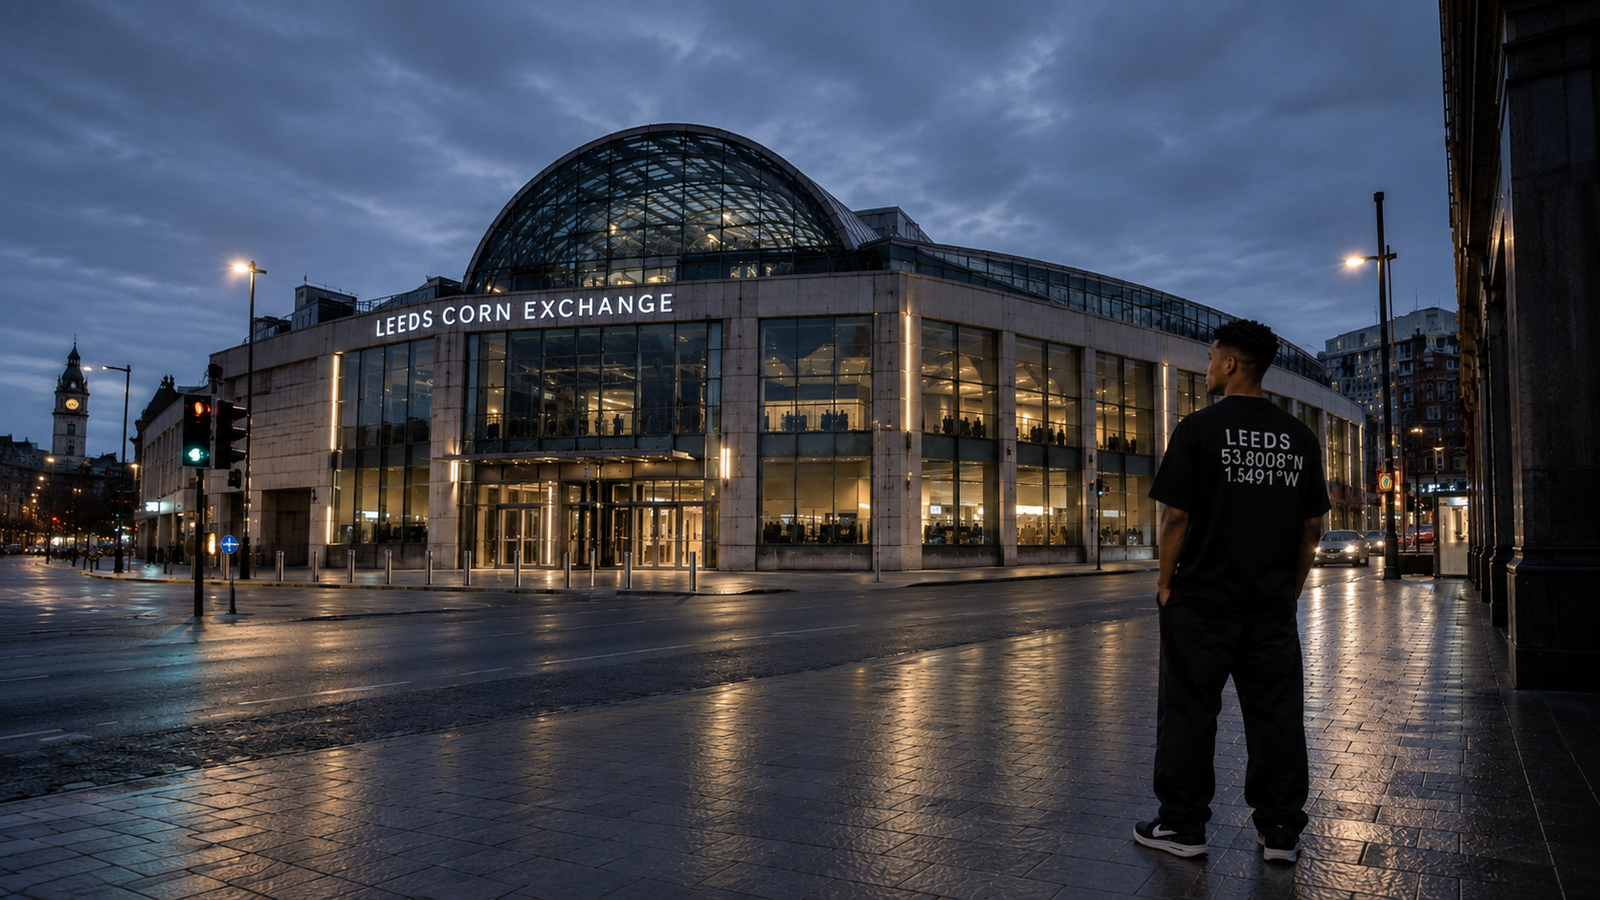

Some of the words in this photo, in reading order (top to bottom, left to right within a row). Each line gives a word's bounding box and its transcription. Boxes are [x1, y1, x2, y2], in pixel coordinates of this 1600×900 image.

[375, 309, 434, 337] LEEDS
[442, 302, 511, 325] CORN
[524, 293, 673, 320] EXCHANGE
[1225, 428, 1291, 450] LEEDS
[1221, 448, 1304, 471] 53.8008°N
[1224, 466, 1300, 487] 1.5491°W
